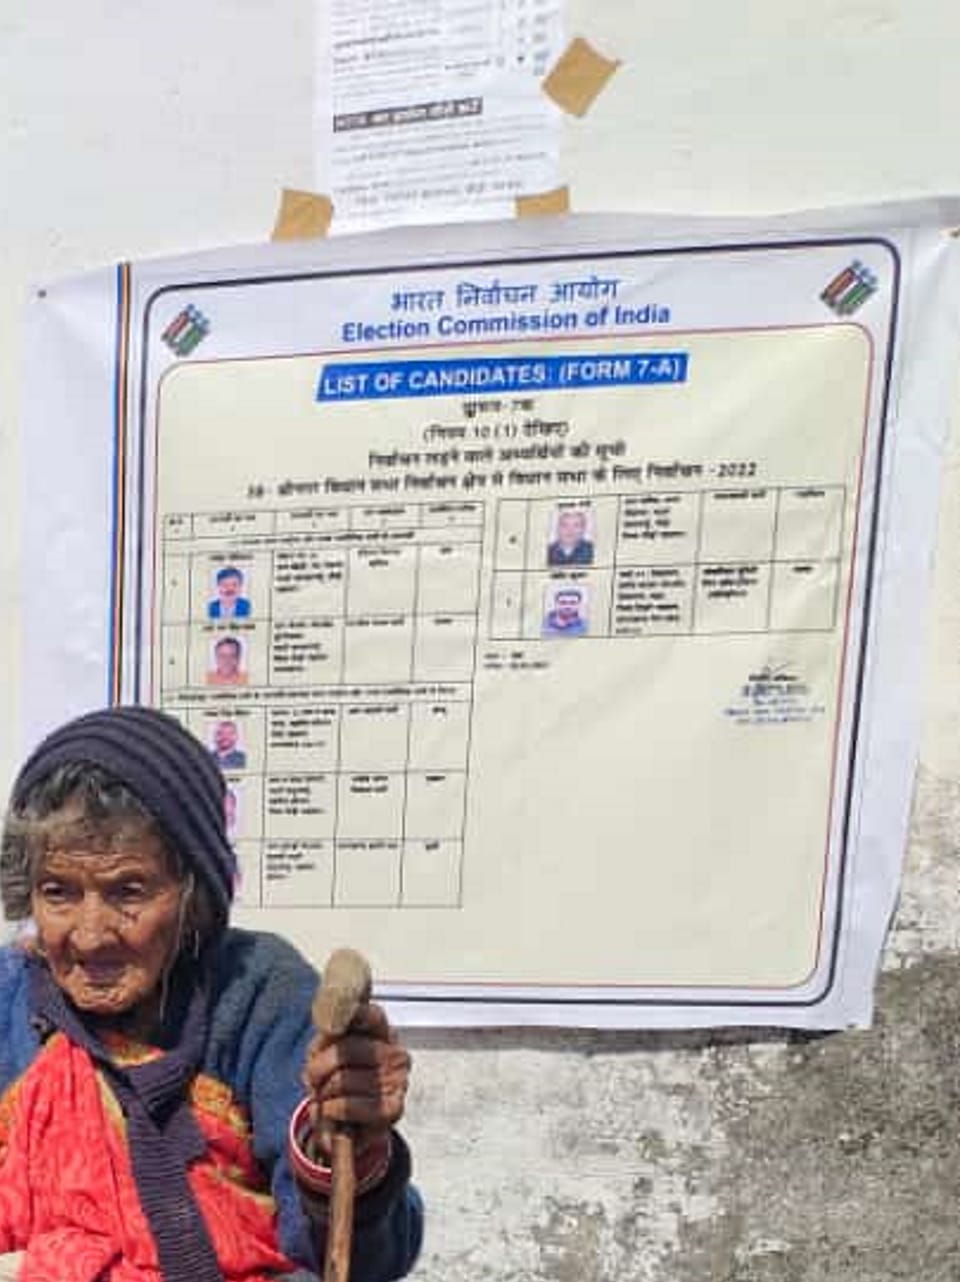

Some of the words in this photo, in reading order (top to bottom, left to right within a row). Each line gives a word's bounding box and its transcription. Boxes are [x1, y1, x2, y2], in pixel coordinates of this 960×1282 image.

[390, 289, 444, 311] भारत
[456, 279, 538, 307] निर्वाचन
[551, 275, 620, 302] आयोग
[342, 319, 430, 342] Election
[439, 310, 578, 336] Commission
[585, 307, 609, 327] of
[615, 304, 672, 326] India
[323, 374, 368, 395] LIST
[374, 371, 402, 393] OF
[409, 364, 546, 391] CANDIDATES
[558, 359, 631, 383] (FORM
[638, 358, 681, 380] 7-A)
